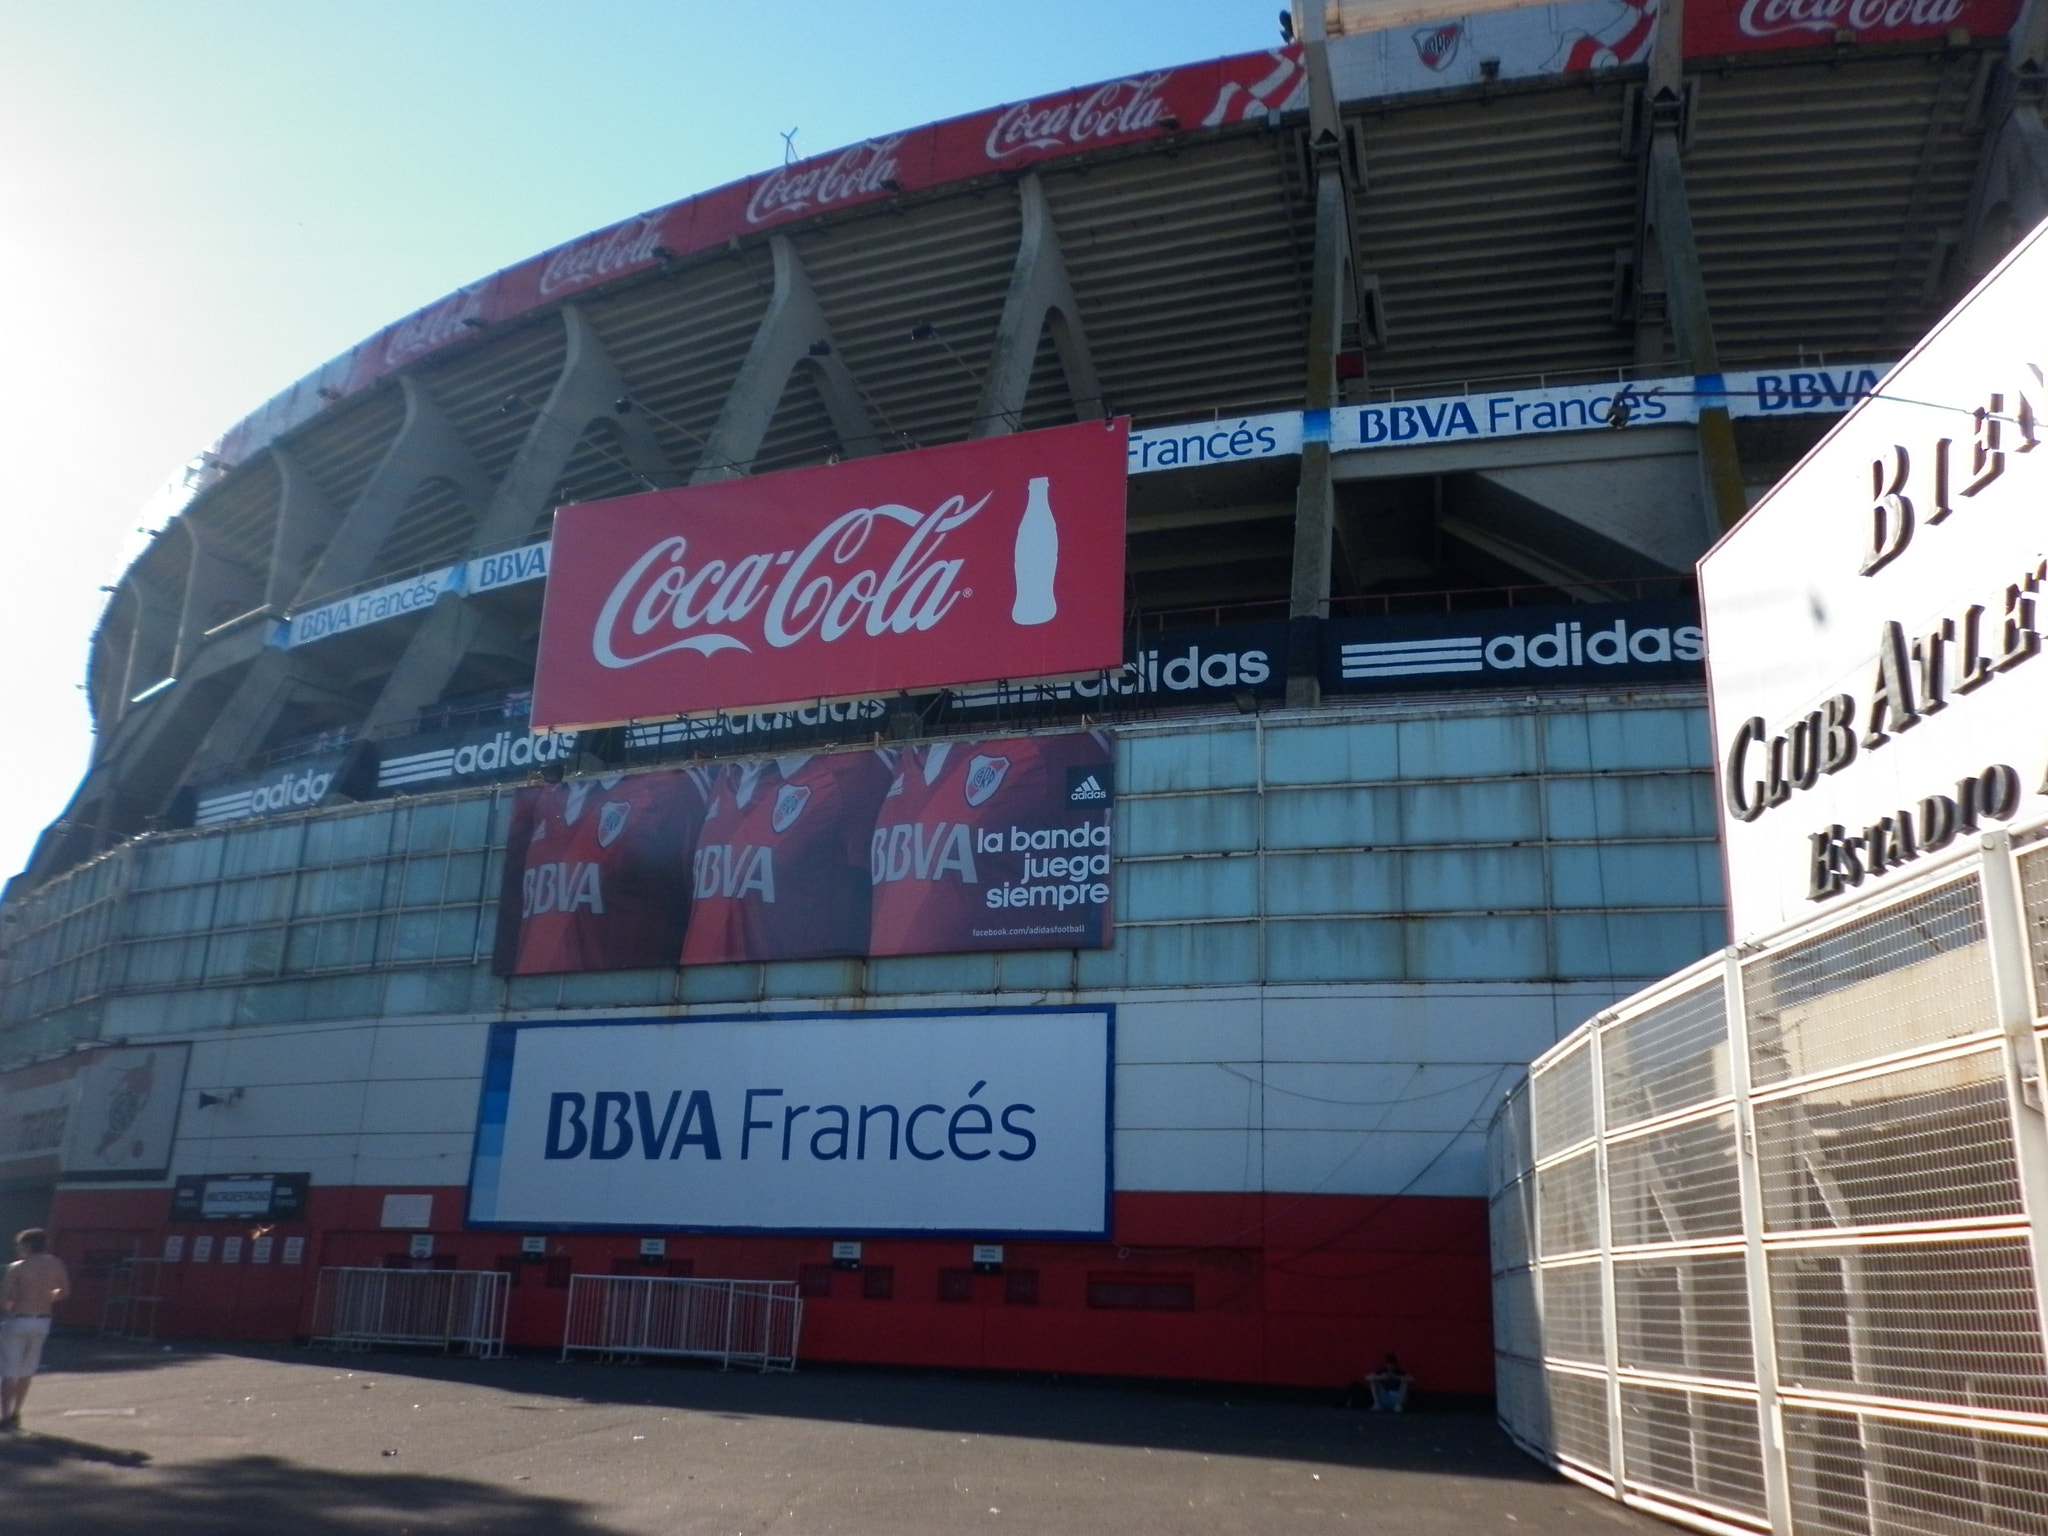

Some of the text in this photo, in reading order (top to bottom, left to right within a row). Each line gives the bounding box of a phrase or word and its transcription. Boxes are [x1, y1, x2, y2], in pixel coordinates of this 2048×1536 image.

[985, 70, 1173, 159] Coca-Cola
[1359, 384, 1666, 443] BBVA Francés
[480, 547, 546, 587] BBVA
[592, 489, 994, 669] Coca-Cola
[301, 576, 437, 640] BBVA Francés
[1485, 620, 1704, 669] adidas
[1726, 553, 2048, 823] CLUB ATLE
[454, 731, 578, 774] adidas
[1071, 789, 1106, 801] adidas
[870, 822, 978, 886] BBVA
[977, 822, 1111, 853] la banda
[1805, 764, 2020, 903] ESTADIO
[522, 862, 604, 919] BBVA
[693, 844, 775, 904] BBVA
[986, 882, 1110, 911] siempre
[1021, 853, 1110, 884] juega
[972, 924, 1085, 937] facebook.com/adidasfootball
[543, 1080, 1037, 1162] BBVA Francés
